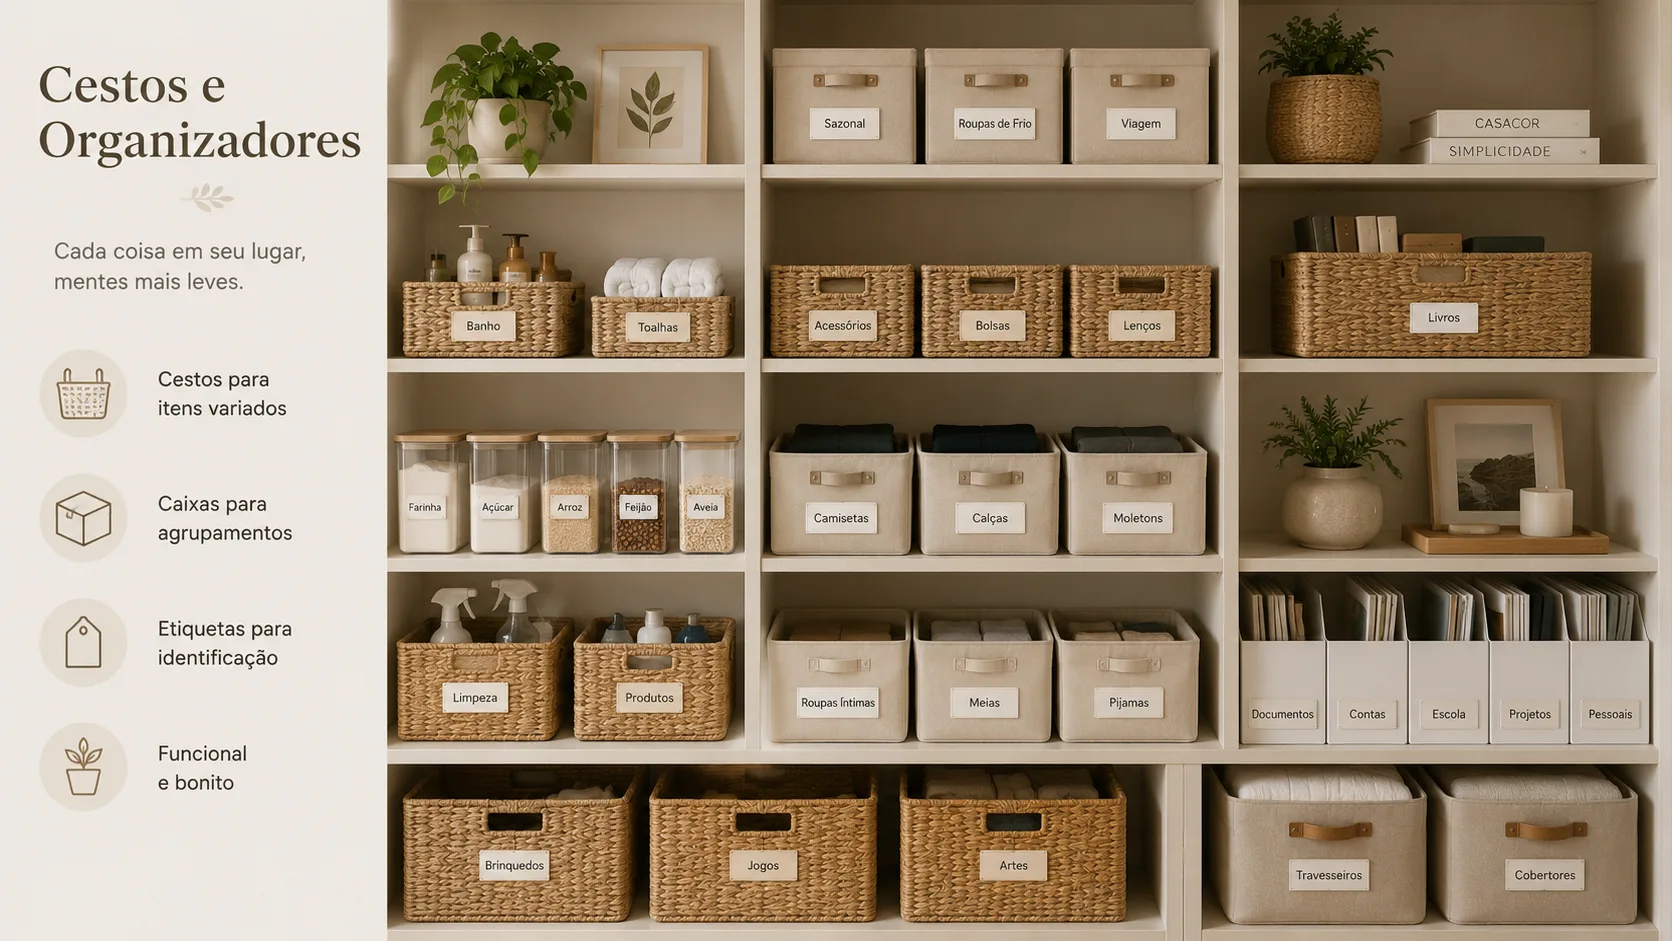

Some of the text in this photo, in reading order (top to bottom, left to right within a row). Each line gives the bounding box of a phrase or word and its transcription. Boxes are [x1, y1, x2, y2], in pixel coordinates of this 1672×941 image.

[824, 118, 866, 129] Sazonal
[958, 117, 1032, 131] Roupas de Frio
[1120, 118, 1162, 132] Viagem
[1475, 117, 1540, 130] CASACOR
[1449, 145, 1551, 157] SIMPLICIDADE
[1428, 312, 1461, 323] Livros
[466, 320, 501, 332] Banho
[637, 321, 679, 333] Toalhas
[814, 319, 872, 331] Acessórios
[975, 320, 1011, 331] Bolsas
[1123, 320, 1162, 334] Lenços
[408, 502, 442, 512] Farinha
[481, 502, 514, 514] Açúcar
[557, 502, 583, 512] Arroz
[693, 502, 719, 512] Aveia
[813, 512, 869, 524] Camisetas
[972, 512, 1009, 526] Calças
[1113, 512, 1164, 524] Moletons
[453, 692, 498, 706] Limpeza
[625, 692, 675, 703] Produtos
[801, 696, 876, 710] Roupas Íntimas
[969, 697, 1001, 708] Meias
[1109, 696, 1150, 711] Pijamas
[1251, 708, 1315, 720] Documentos
[1349, 708, 1386, 720] Contas
[1432, 708, 1466, 720] Escola
[1509, 708, 1552, 722] Projetos
[1588, 708, 1633, 720] Pessoais
[485, 859, 545, 873] Brinquedos
[747, 860, 780, 873] Jogos
[999, 860, 1029, 871] Artes
[1295, 869, 1363, 881] Travesseiros
[1514, 869, 1576, 881] Cobertores
